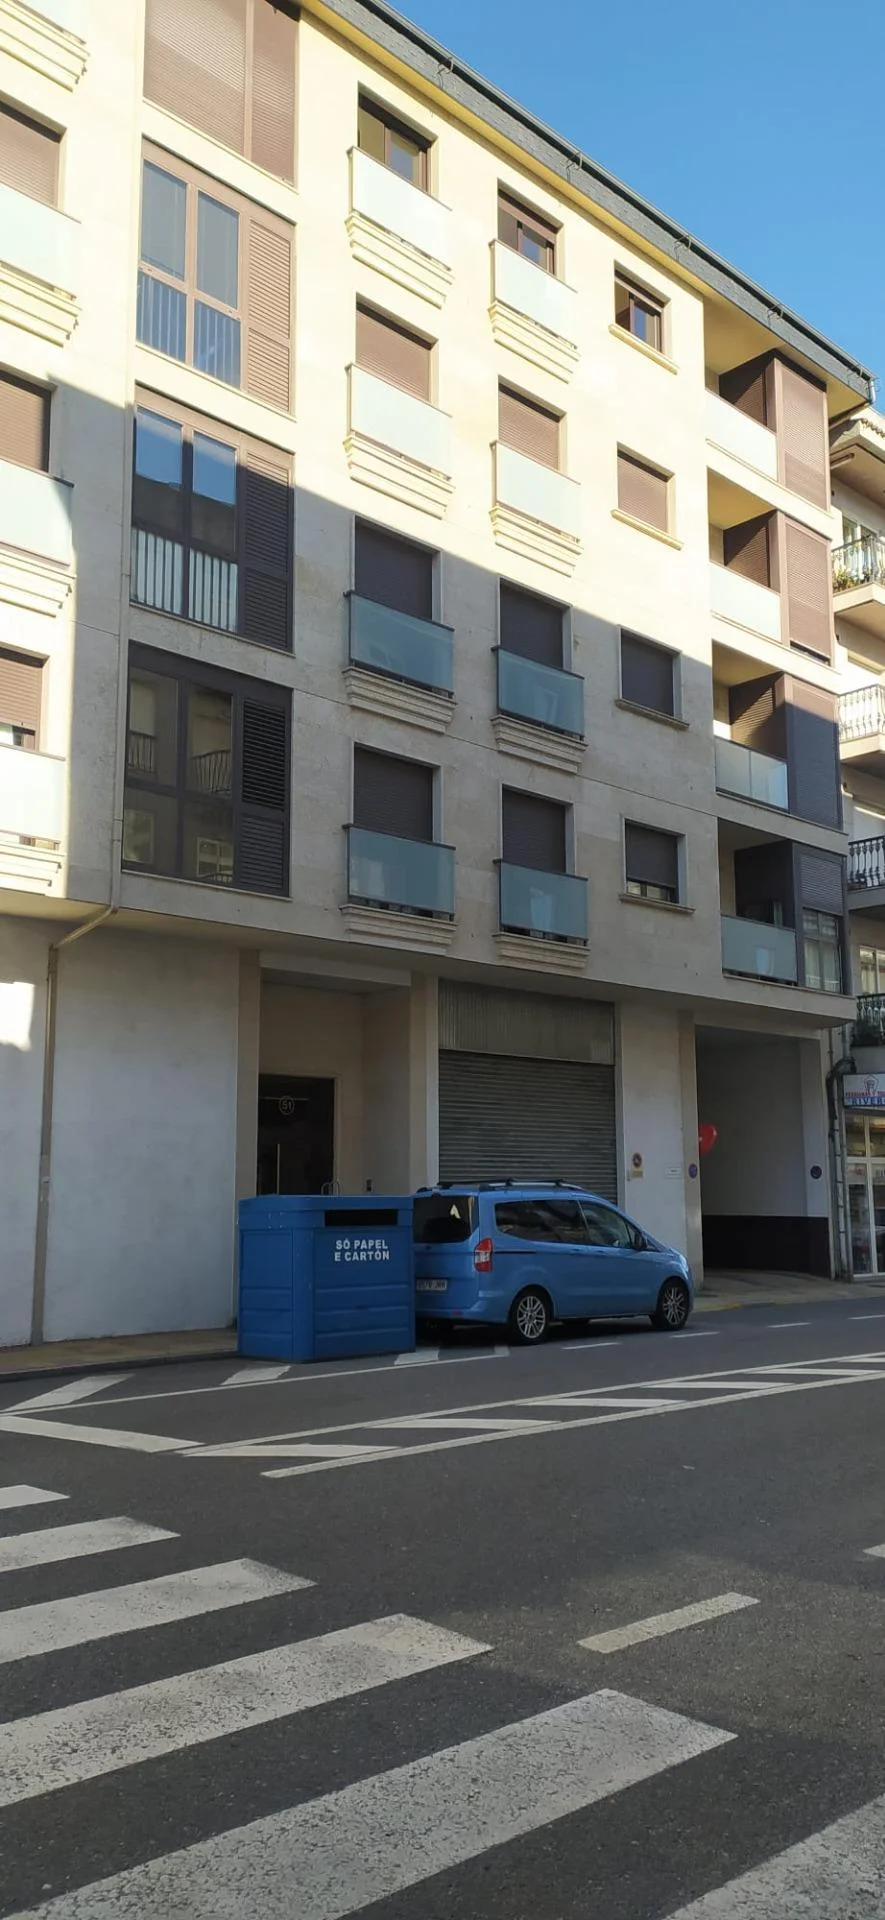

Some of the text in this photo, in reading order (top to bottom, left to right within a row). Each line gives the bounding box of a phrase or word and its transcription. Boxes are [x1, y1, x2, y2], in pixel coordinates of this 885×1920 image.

[282, 1100, 292, 1110] 51
[336, 1238, 388, 1250] SÓ PAPEL
[334, 1249, 390, 1262] E CARTÓN
